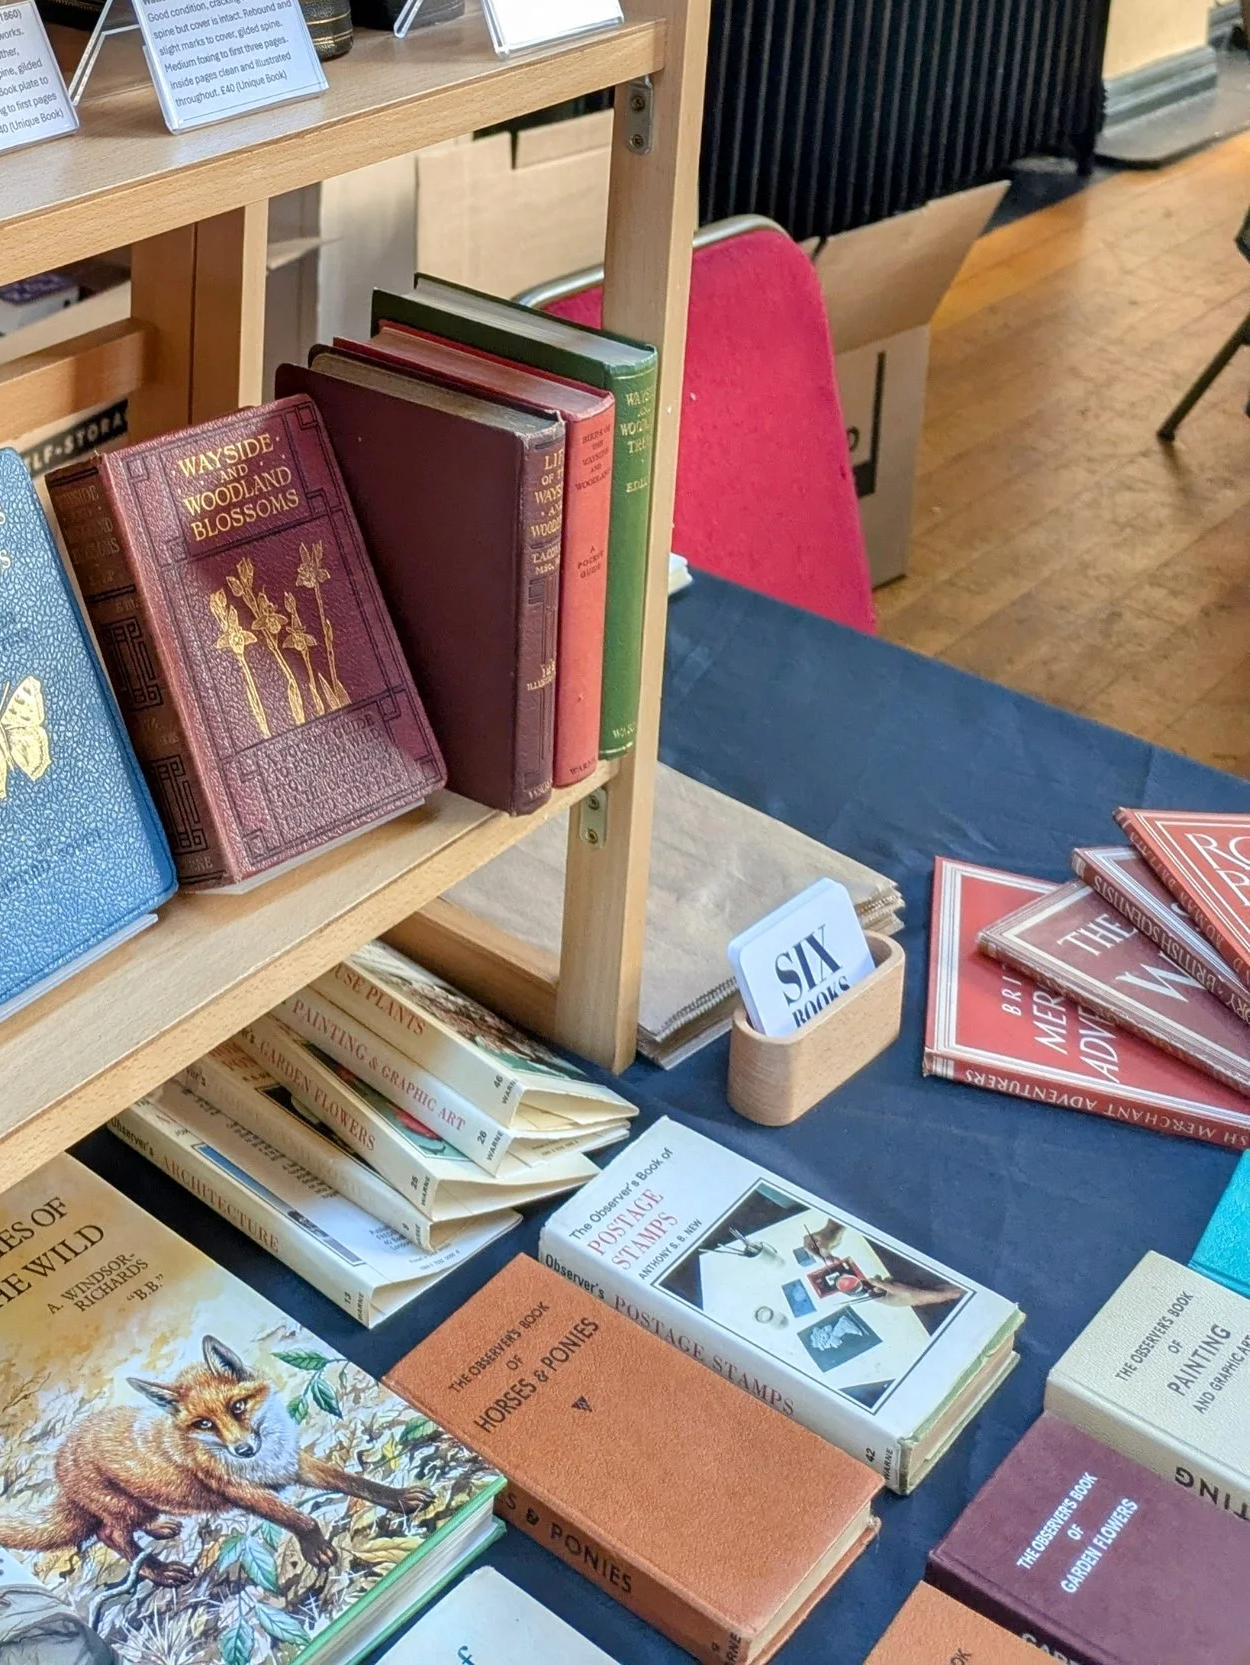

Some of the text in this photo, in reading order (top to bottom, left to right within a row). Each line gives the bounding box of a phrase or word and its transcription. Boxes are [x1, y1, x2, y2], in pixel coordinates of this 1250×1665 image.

[148, 12, 170, 23] Good
[170, 3, 209, 19] condition,
[178, 433, 274, 478] WAYSIDE
[220, 464, 248, 483] AND
[183, 467, 291, 516] WOODLAND
[191, 489, 299, 541] BLOSSOMS
[1057, 914, 1138, 956] THE
[1094, 875, 1160, 944] SCIENTISTS
[775, 923, 843, 1008] SIX
[292, 997, 370, 1063] PAINTING
[366, 986, 426, 1036] PLANTS
[259, 1041, 311, 1091] GARDEN
[313, 1085, 376, 1151] FLOWERS
[369, 1057, 505, 1161] & GRAPHIC ART 26 WARNE
[964, 1069, 1216, 1138] MERCHANT ADVENTURERS
[31, 1196, 69, 1228] OF
[162, 1156, 280, 1253] ARCHITECTURE
[569, 1147, 674, 1241] The Observer's Book of
[587, 1189, 664, 1256] POSTAGE
[22, 1224, 104, 1277] WILD
[612, 1211, 678, 1271] STAMPS
[639, 1218, 703, 1281] ANTHONY NEW
[61, 1252, 136, 1301] WINDSOR-
[75, 1258, 149, 1312] RICHARDS
[448, 1301, 550, 1395] THE OBSERVER'S BOOK
[506, 1353, 523, 1372] OF
[545, 1254, 795, 1417] Observer's POSTAGE STAMPS
[1115, 1290, 1194, 1382] THE OBSERVER'S BOOK
[1167, 1323, 1232, 1397] PAINTING
[1168, 1339, 1184, 1354] OF
[474, 1317, 599, 1434] HORSES & PONIES
[1193, 1348, 1246, 1415] AND GRAPHIC
[1016, 1471, 1098, 1570] THE OBSERVER'S BOOK
[1061, 1498, 1138, 1594] GARDEN FLOWERS
[1067, 1523, 1084, 1541] OF
[549, 1522, 632, 1594] PONIES
